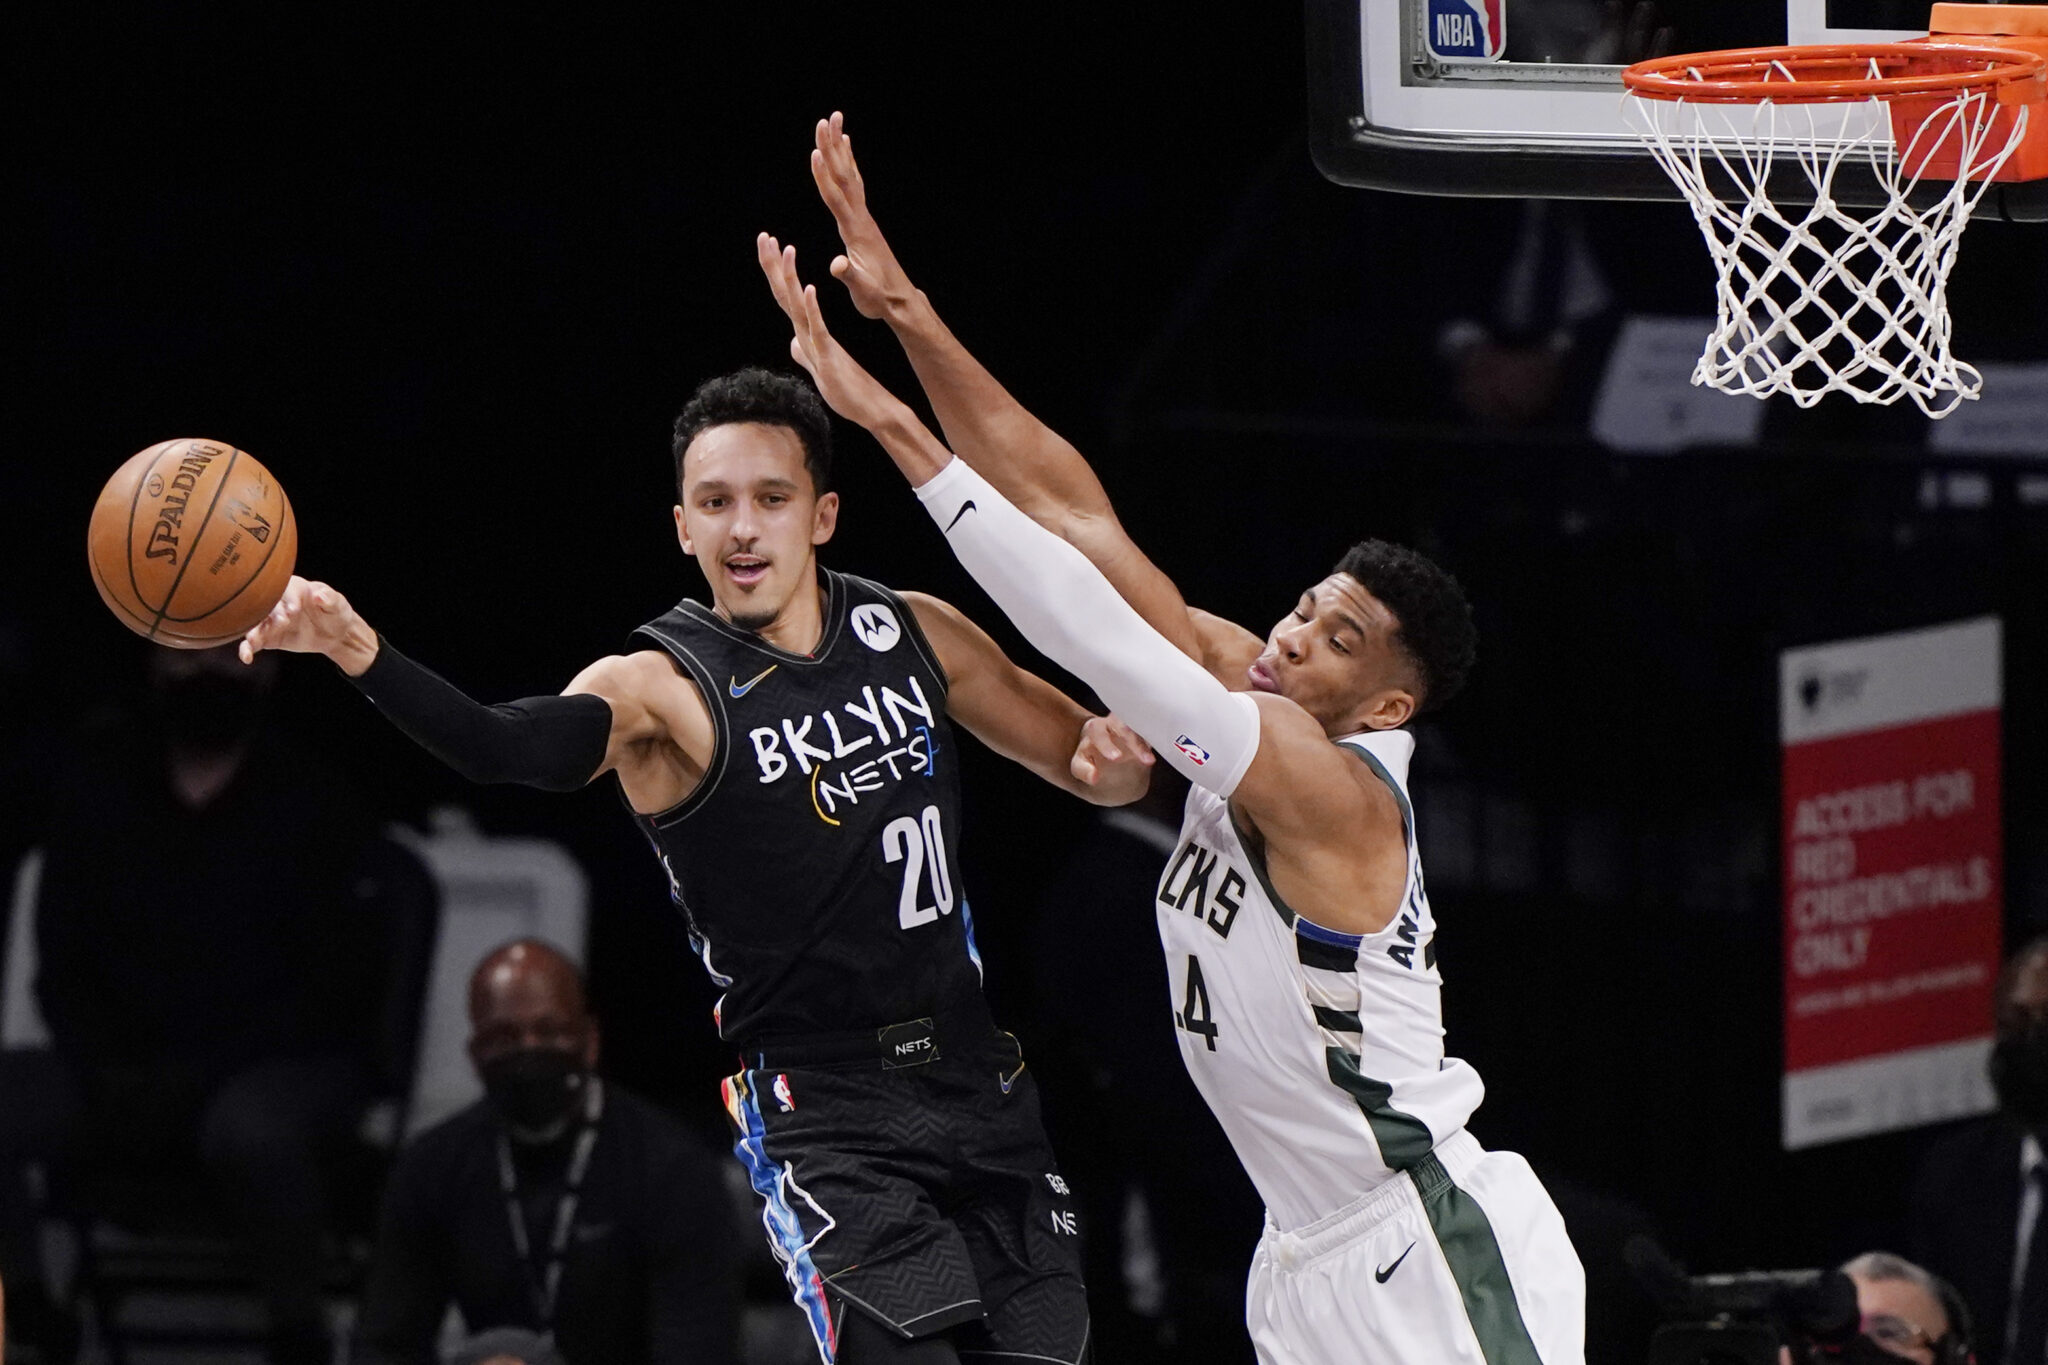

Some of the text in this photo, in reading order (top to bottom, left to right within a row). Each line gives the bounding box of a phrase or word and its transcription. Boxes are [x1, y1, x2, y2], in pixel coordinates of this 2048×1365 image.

[1437, 14, 1475, 47] NBA
[146, 443, 224, 566] SPALDING
[749, 675, 935, 784] BKLYN
[819, 735, 929, 813] NETS
[882, 804, 954, 930] 20
[1158, 841, 1247, 940] CKS
[895, 1036, 932, 1056] NETS
[1175, 953, 1219, 1053] 4
